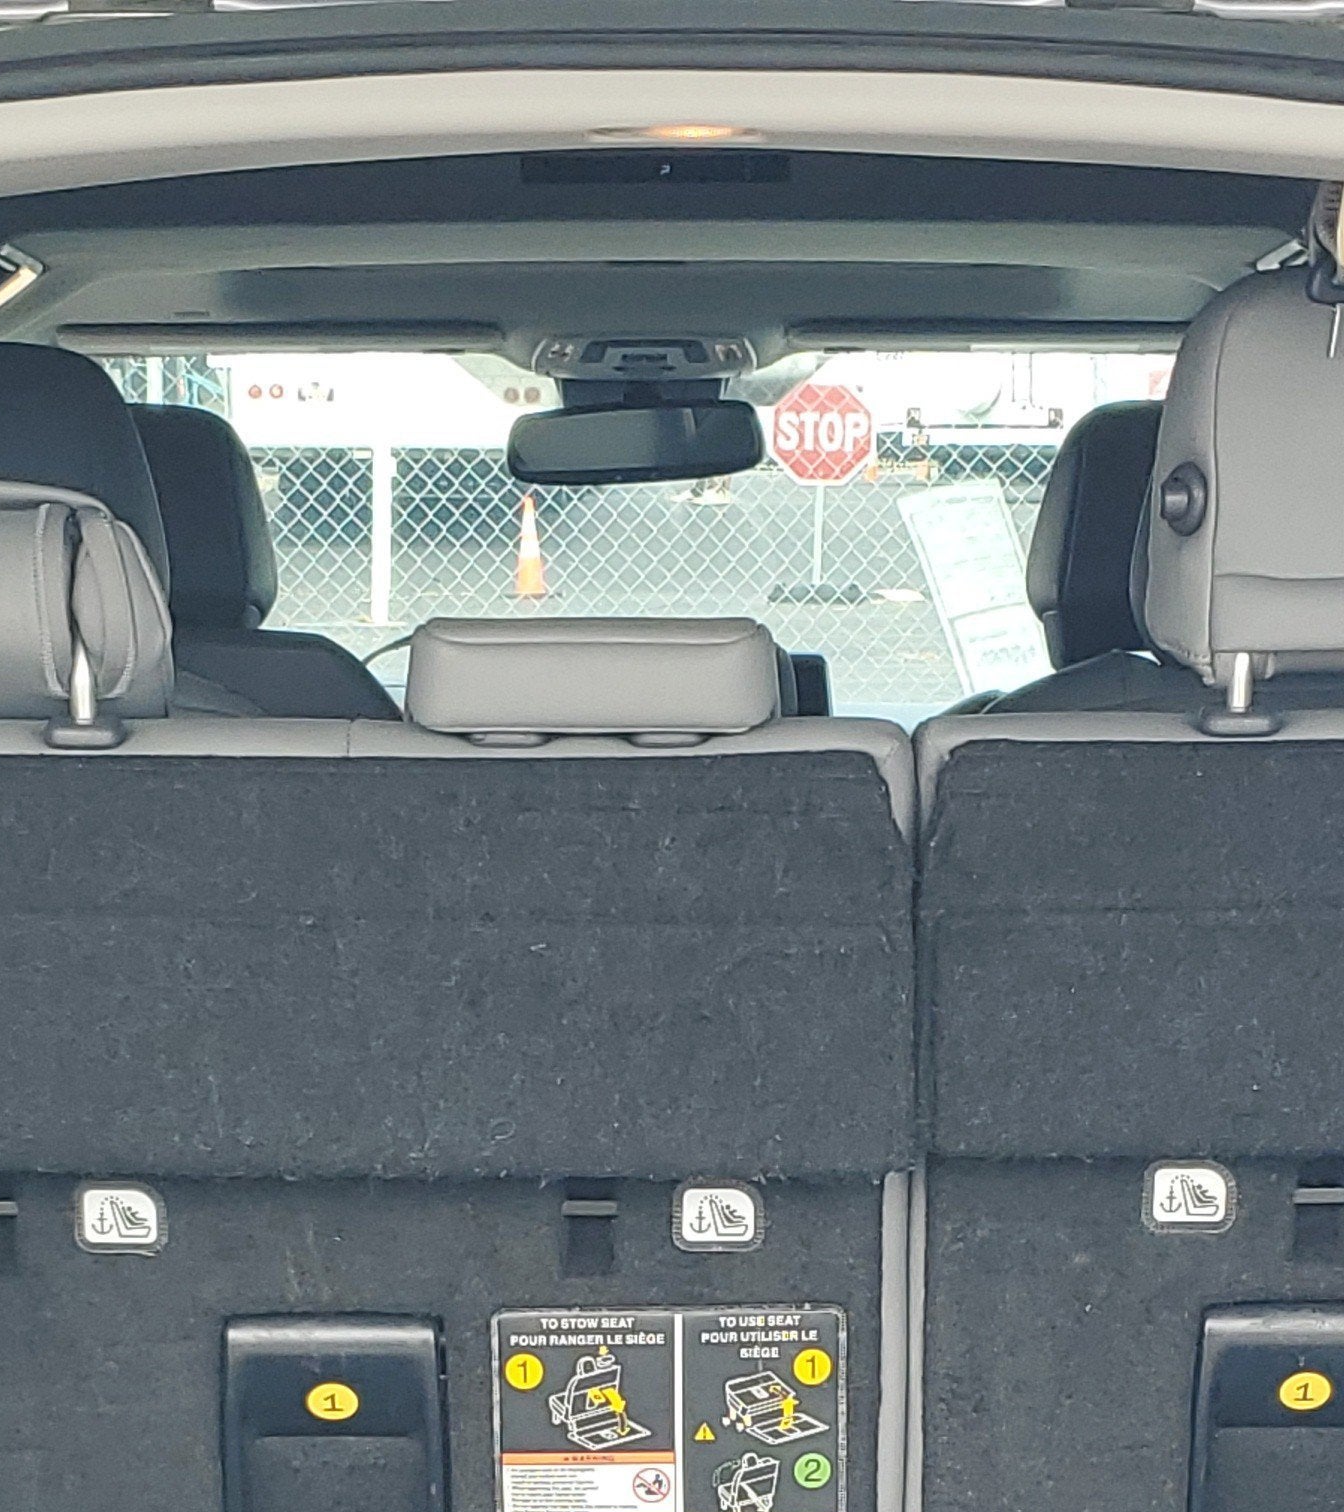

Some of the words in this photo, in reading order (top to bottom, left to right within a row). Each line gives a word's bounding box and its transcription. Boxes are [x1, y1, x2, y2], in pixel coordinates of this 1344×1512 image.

[776, 411, 871, 451] STOP
[540, 1318, 558, 1329] TO
[560, 1318, 598, 1329] STOW
[601, 1317, 635, 1329] SEAT
[718, 1316, 736, 1328] TO
[739, 1315, 765, 1327] USE
[767, 1315, 801, 1327] SEAT
[509, 1334, 546, 1346] POUR
[549, 1334, 604, 1345] RANGER
[607, 1333, 623, 1345] LE
[625, 1331, 666, 1345] SIÈGE
[700, 1332, 738, 1343] POUR
[739, 1330, 798, 1342] UTILISER
[801, 1329, 818, 1341] LE
[739, 1345, 780, 1358] SIÈGE
[516, 1360, 528, 1384] 1
[805, 1355, 816, 1380] 1
[1293, 1382, 1314, 1402] 1
[323, 1393, 344, 1412] 1
[804, 1458, 823, 1482] 2
